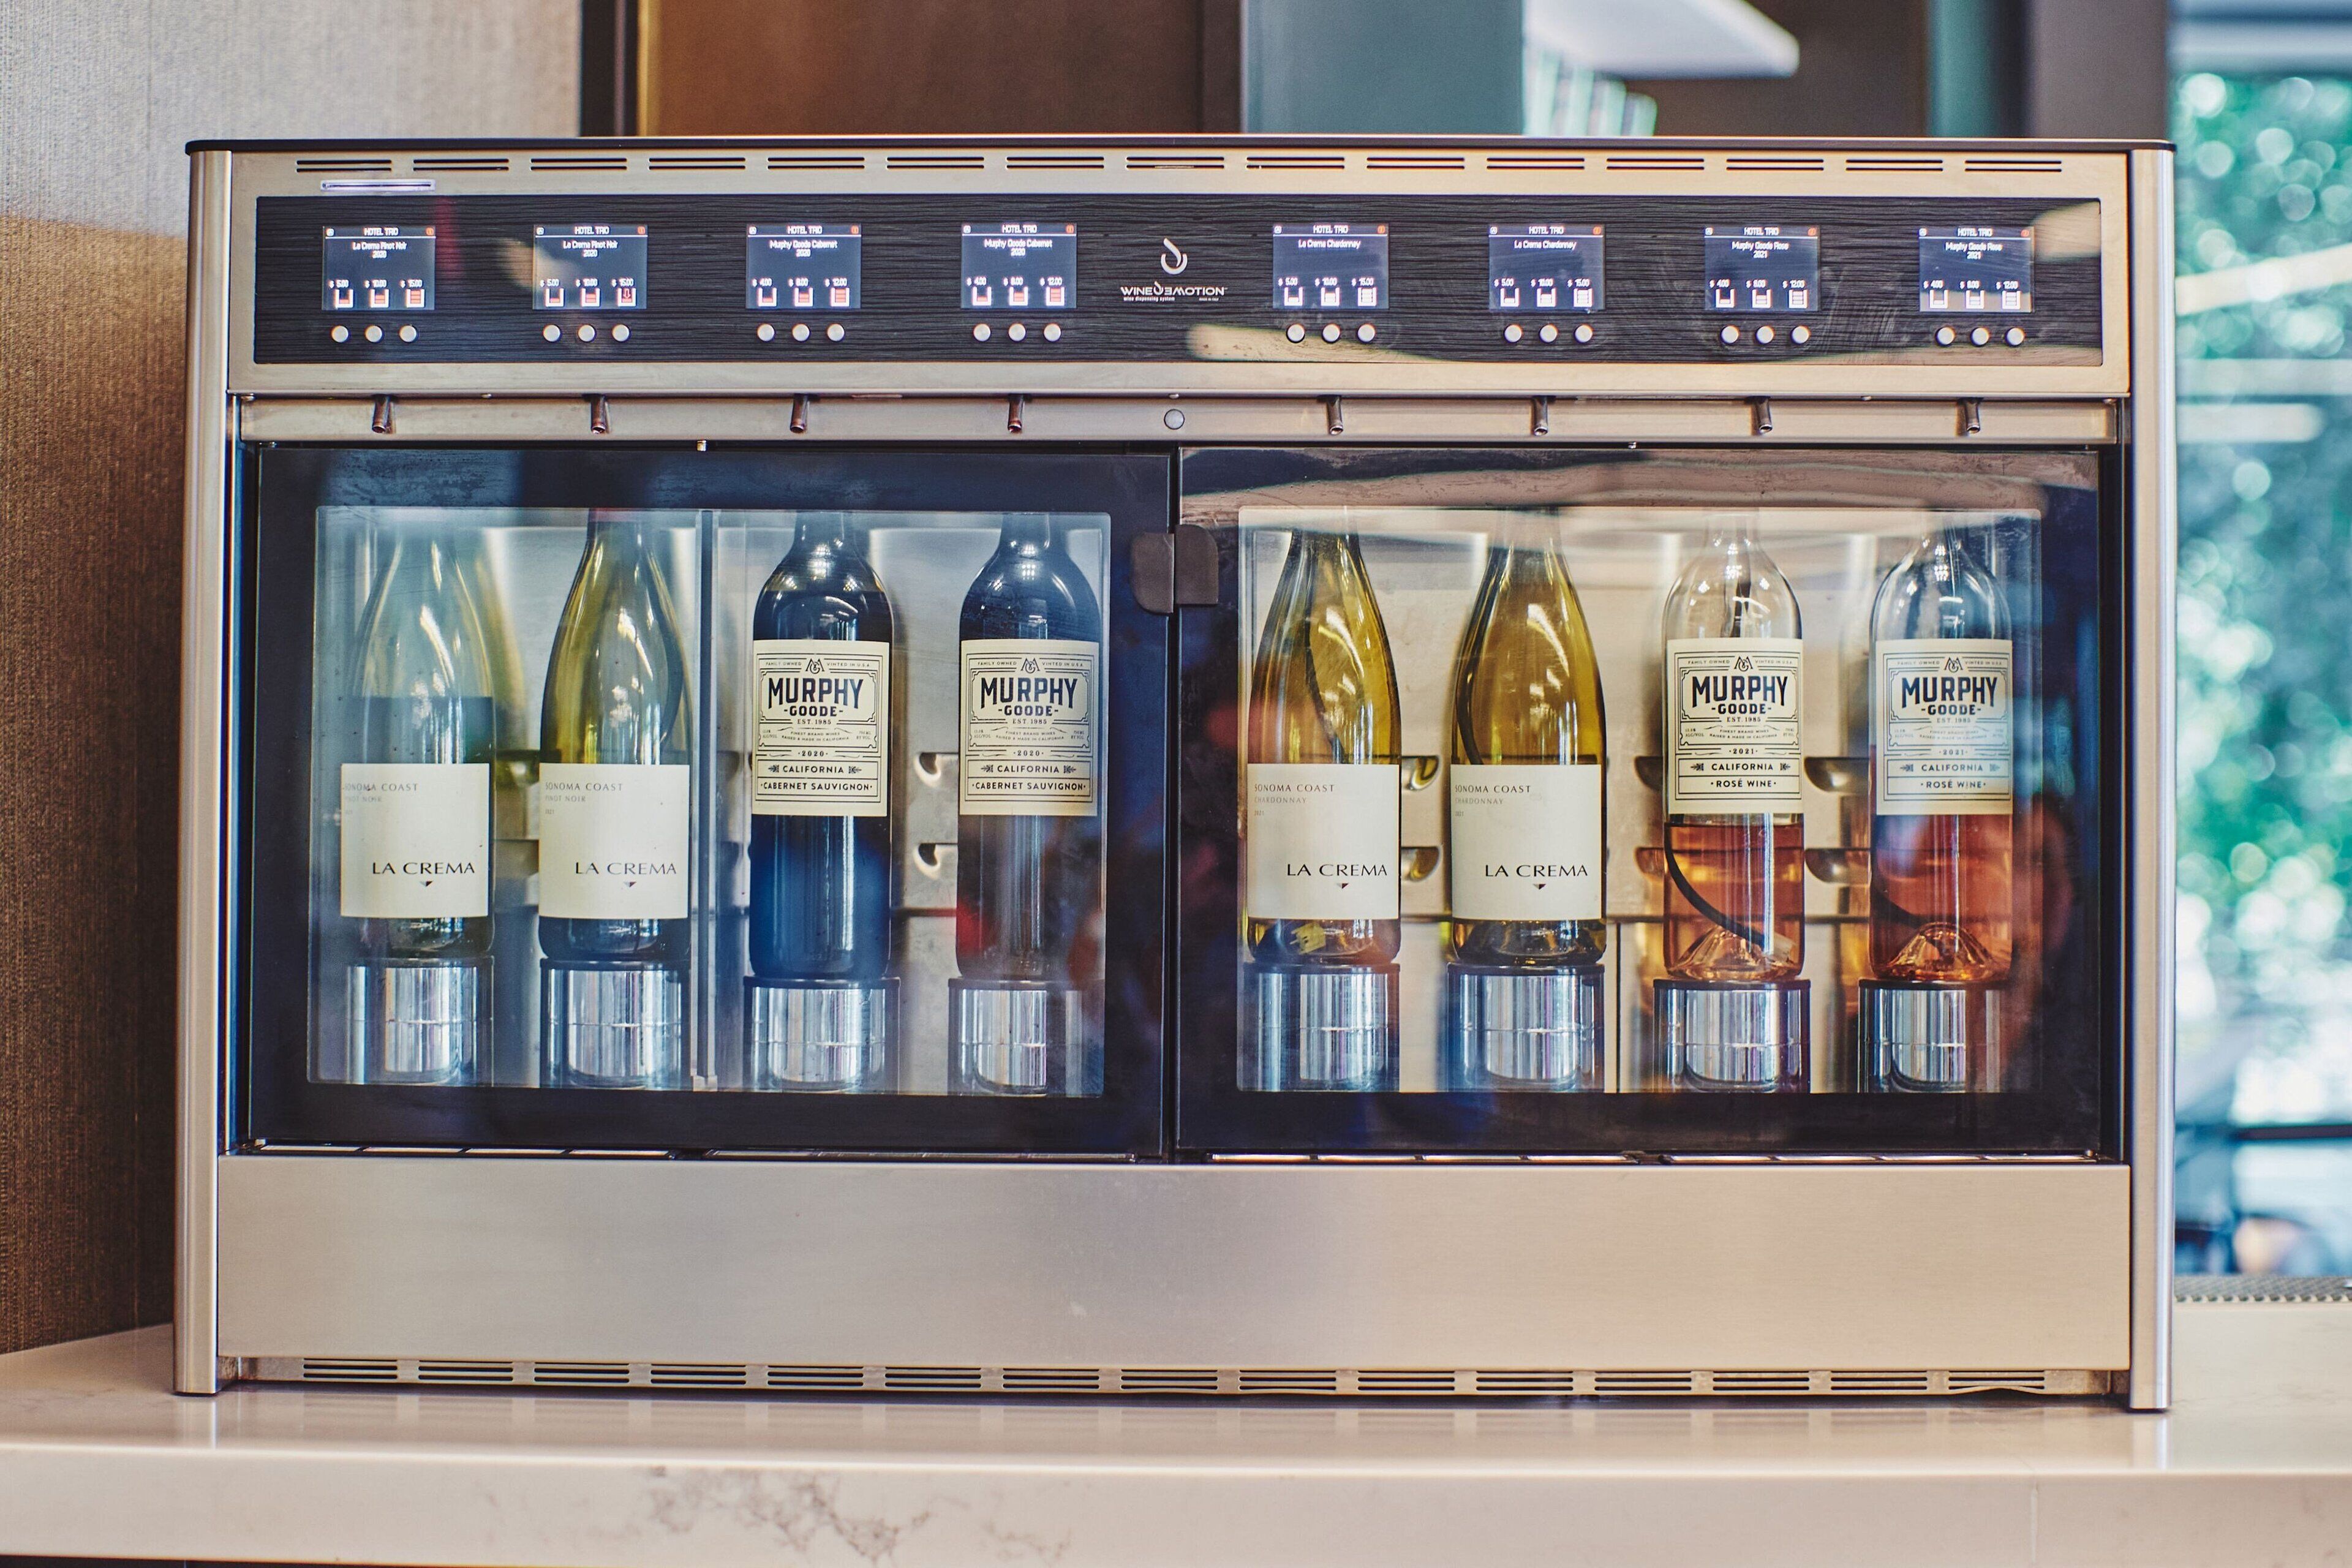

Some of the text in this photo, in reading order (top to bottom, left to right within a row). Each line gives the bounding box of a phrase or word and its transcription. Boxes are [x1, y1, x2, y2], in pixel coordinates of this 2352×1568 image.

[769, 678, 863, 709] MURPHY
[981, 677, 1077, 709] MURPHY
[1692, 676, 1788, 707] MURPHY
[1902, 677, 1997, 708] MURPHY
[1716, 778, 1743, 787] ROSÉ
[372, 862, 475, 874] LA CREMA
[576, 862, 677, 874] LA CREMA
[1287, 864, 1387, 876] LA CREMA
[1485, 865, 1588, 877] LA CREMA
